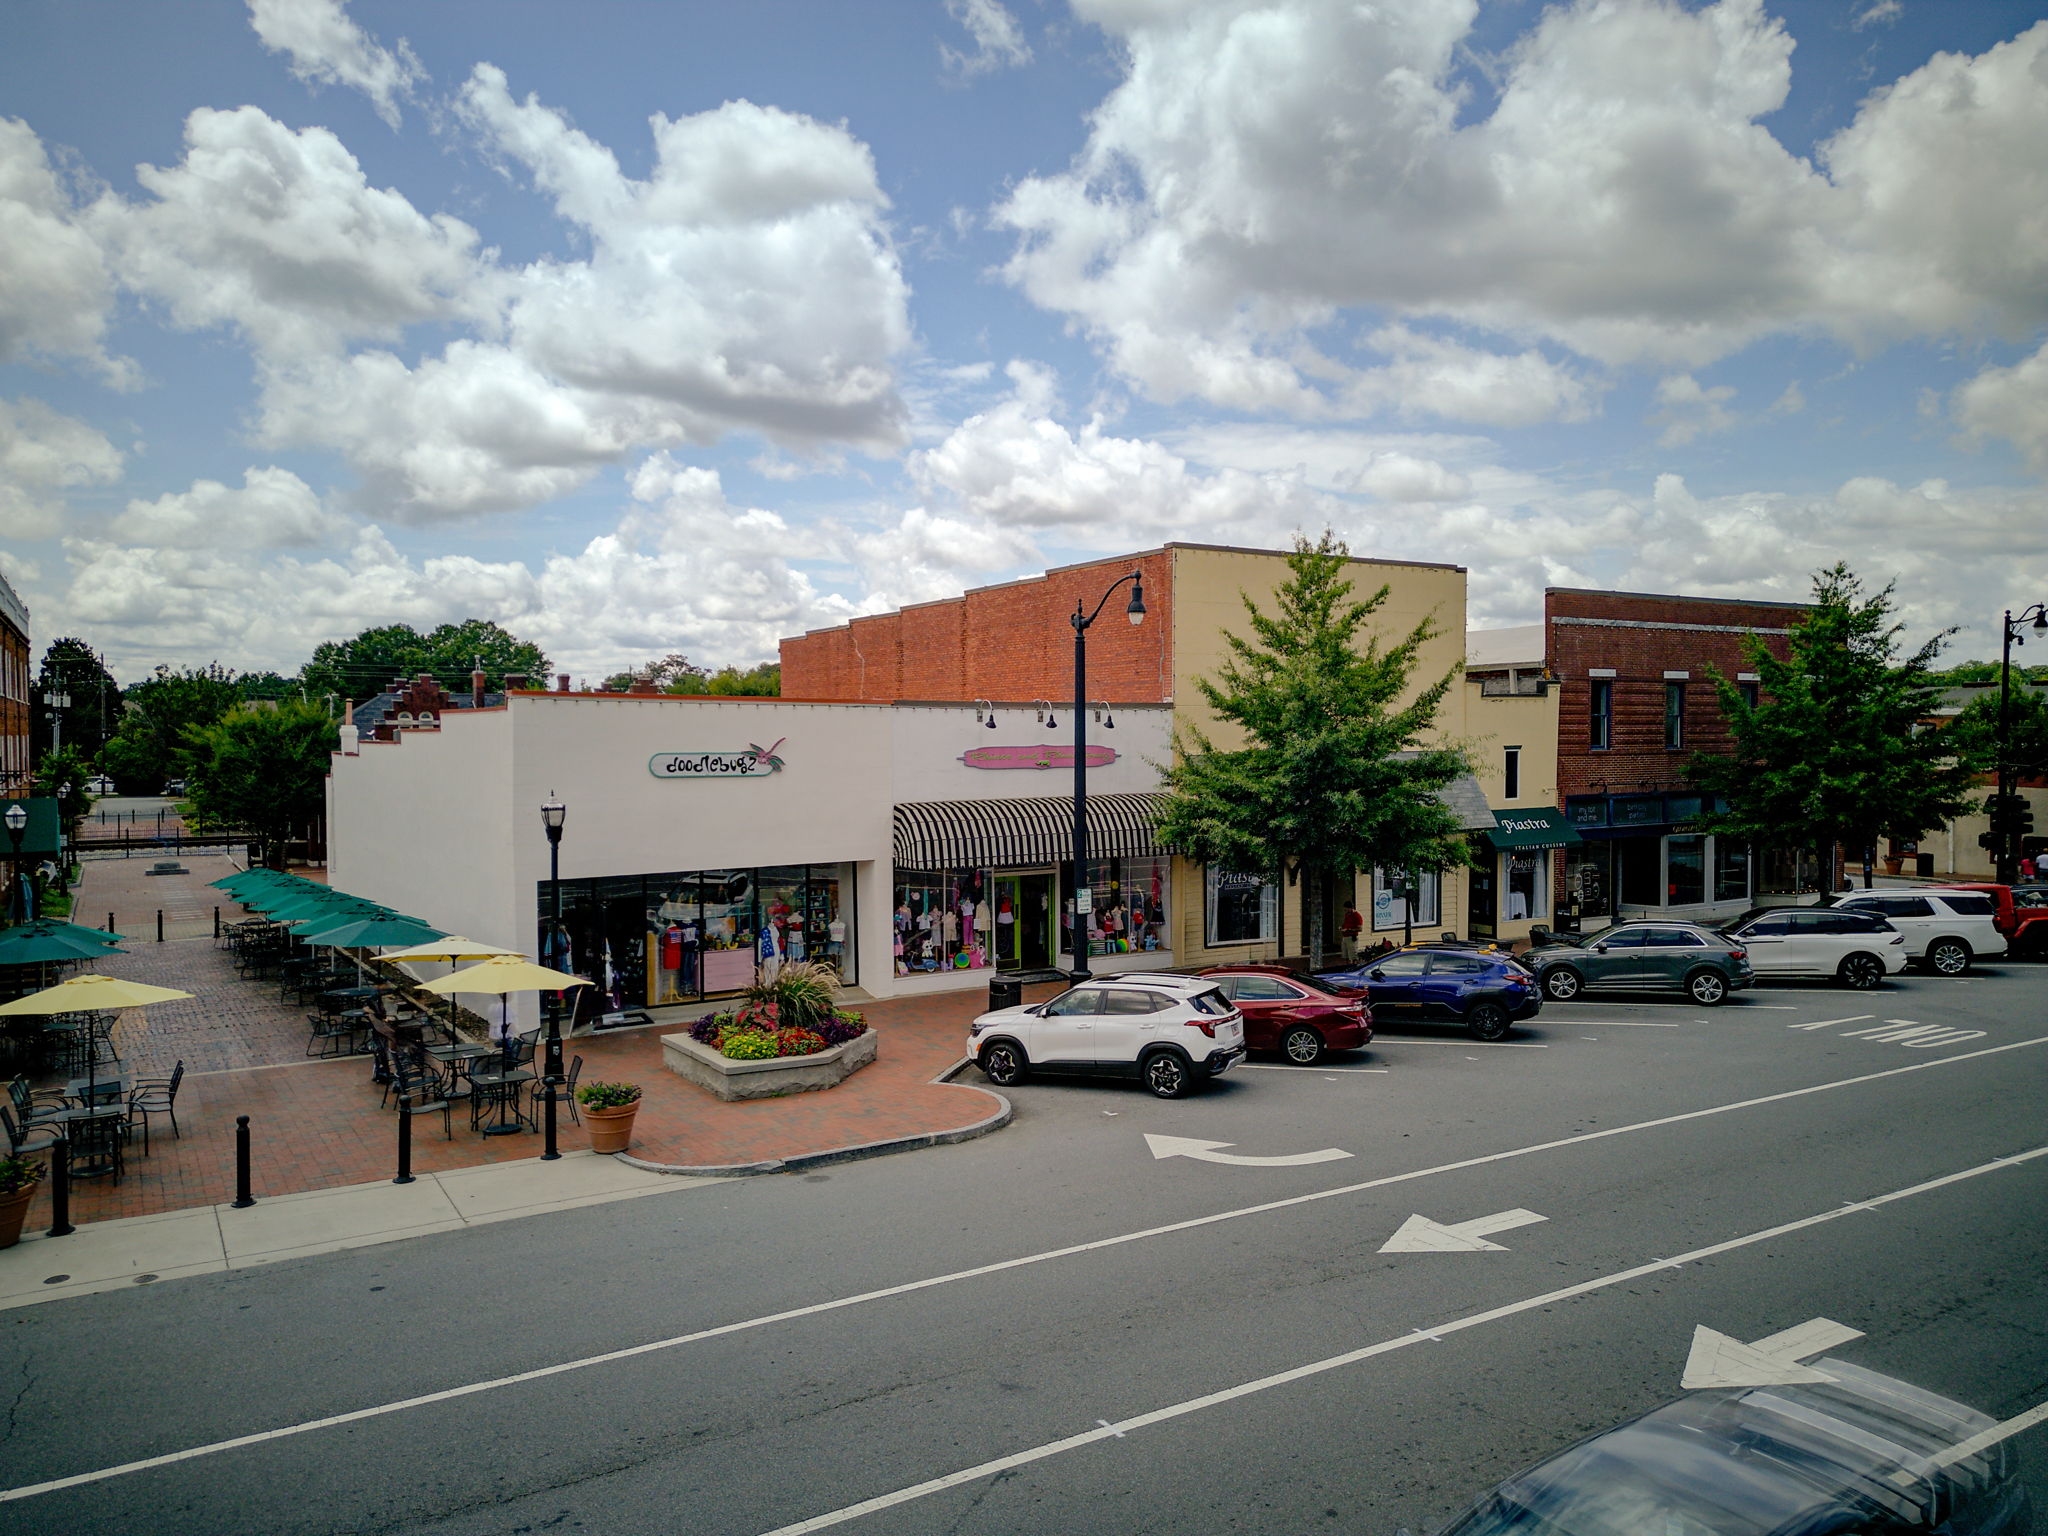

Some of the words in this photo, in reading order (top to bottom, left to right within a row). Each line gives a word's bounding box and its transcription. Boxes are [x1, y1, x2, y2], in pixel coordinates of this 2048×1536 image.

[666, 755, 757, 774] doodlebugz
[1501, 818, 1551, 834] Piastra
[1541, 841, 1566, 849] CUISINE
[1507, 857, 1543, 872] Piastra
[1786, 1014, 1988, 1048] ONLY
